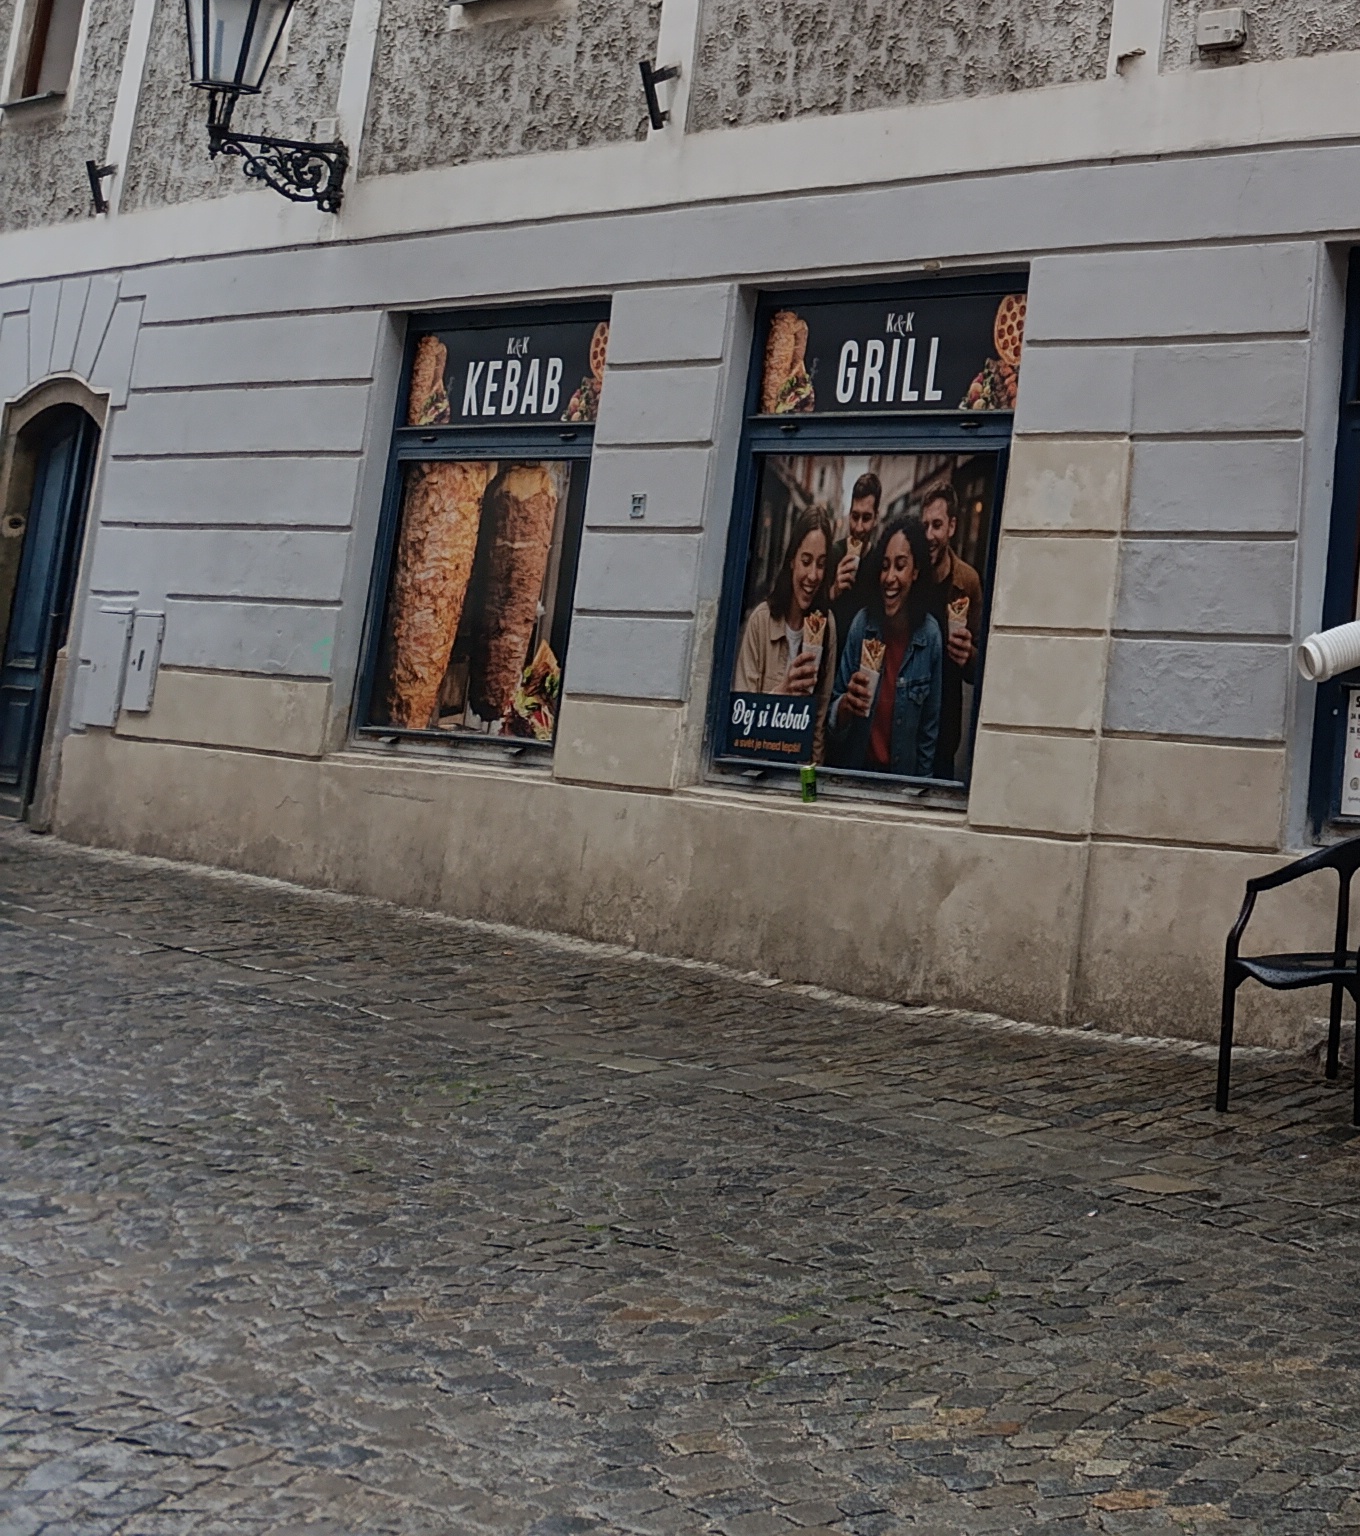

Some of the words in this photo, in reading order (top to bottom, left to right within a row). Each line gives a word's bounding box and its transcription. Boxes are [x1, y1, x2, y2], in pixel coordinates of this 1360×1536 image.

[886, 312, 914, 337] K&K
[507, 336, 530, 358] K&K
[462, 358, 563, 416] KEBAB
[836, 337, 942, 403] GRILL
[732, 699, 756, 735] Dej
[758, 704, 770, 727] si
[771, 703, 810, 730] kebab
